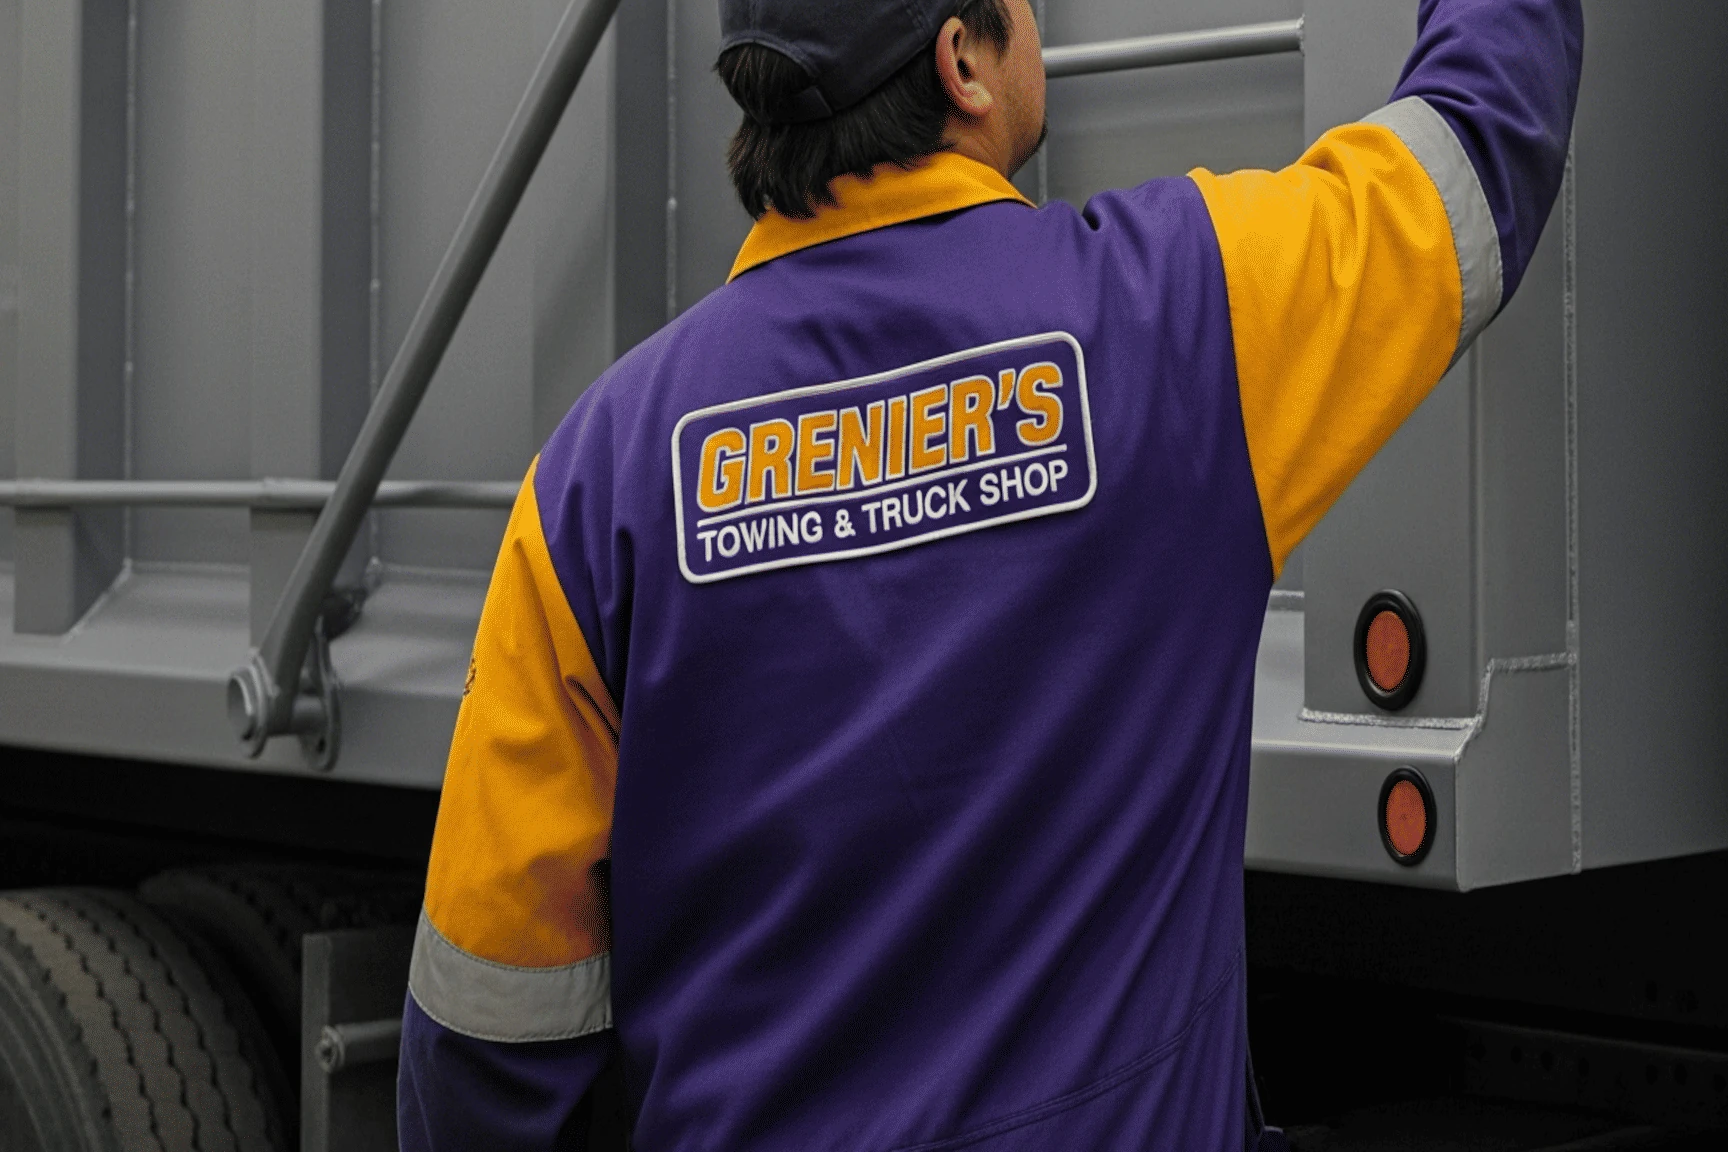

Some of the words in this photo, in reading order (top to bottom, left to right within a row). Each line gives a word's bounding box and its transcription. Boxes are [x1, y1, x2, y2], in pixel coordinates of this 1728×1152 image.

[696, 361, 1064, 514] GRENIER'S
[697, 512, 823, 562] TOWING
[834, 509, 856, 538] &
[862, 479, 972, 535] TRUCK
[979, 459, 1069, 506] SHOP
